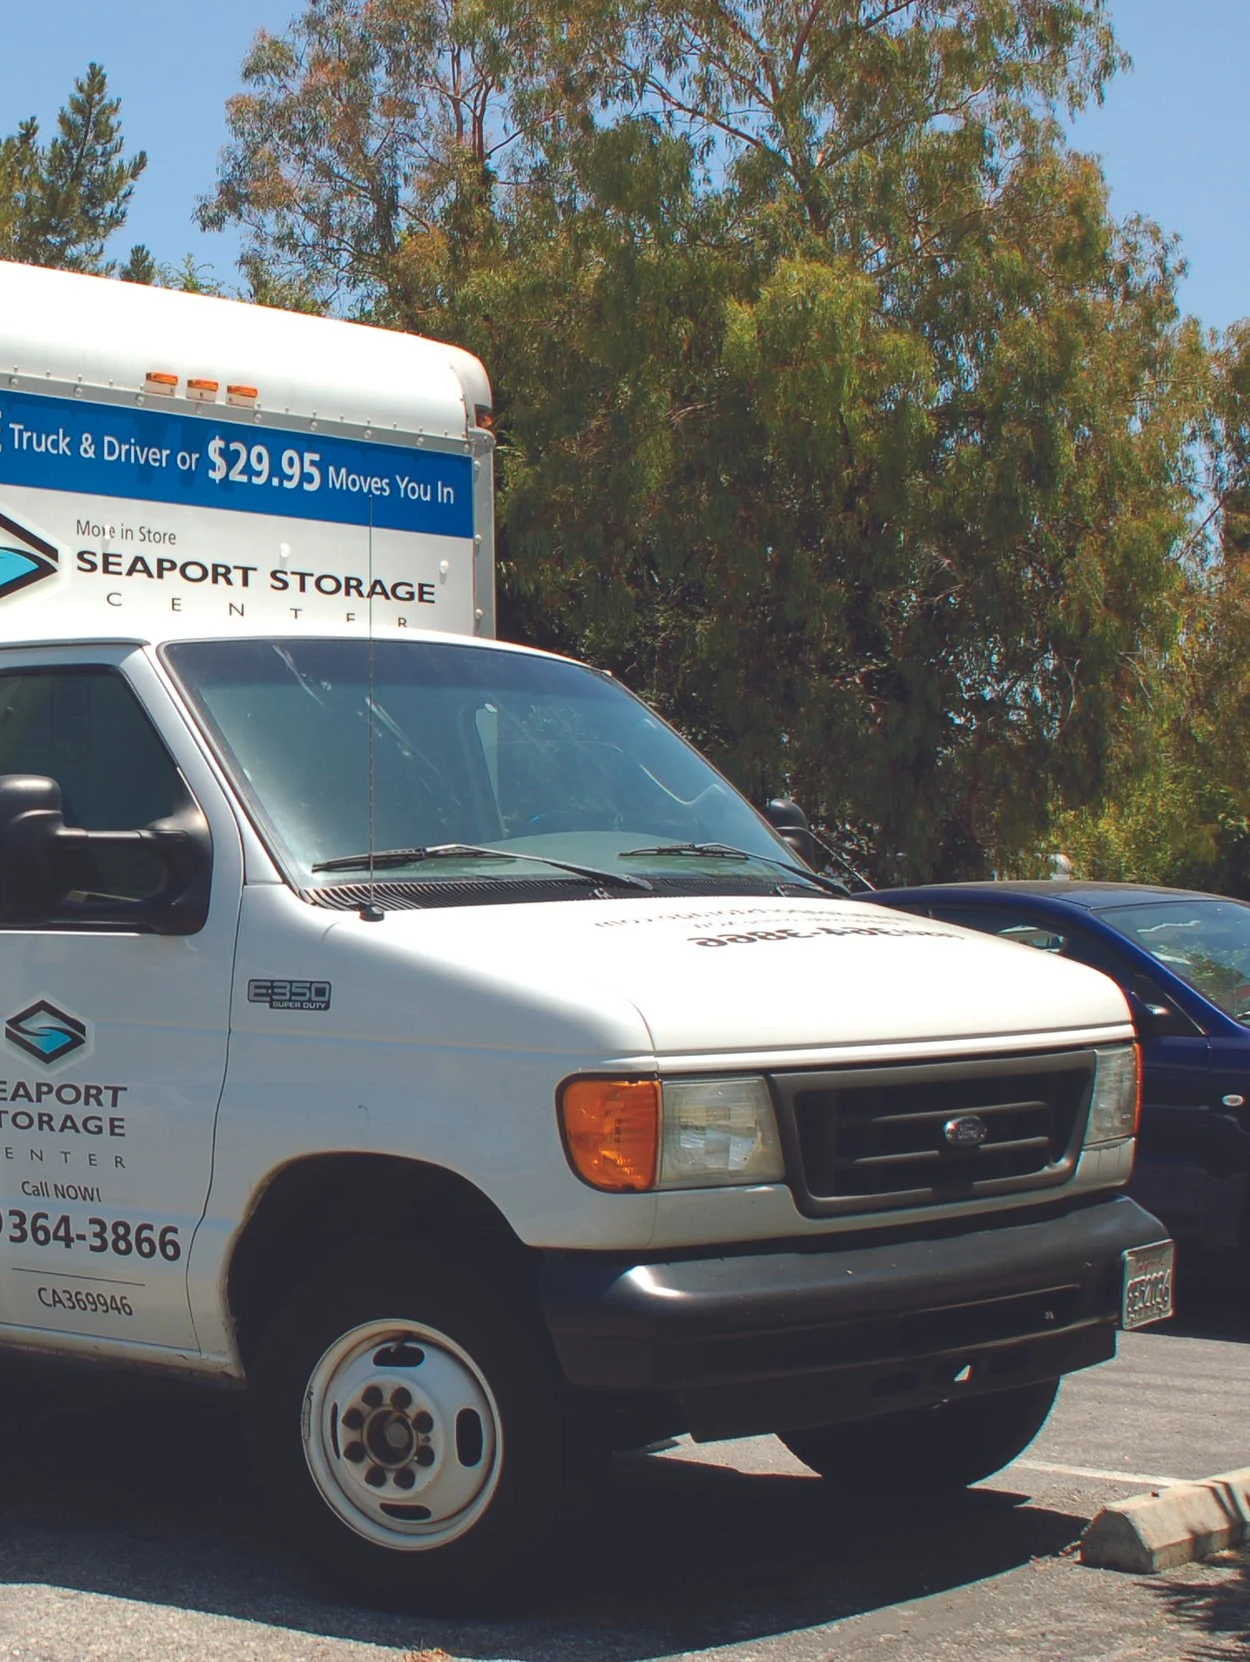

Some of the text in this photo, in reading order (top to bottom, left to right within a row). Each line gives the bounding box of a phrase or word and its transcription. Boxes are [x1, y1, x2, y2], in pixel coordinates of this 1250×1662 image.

[9, 423, 71, 456] Truck
[79, 432, 96, 459] &
[104, 436, 170, 468] Driver
[177, 451, 199, 471] or
[208, 435, 321, 491] $29.95
[328, 466, 391, 496] Moves
[396, 475, 431, 502] You
[438, 480, 455, 504] In
[120, 523, 134, 541] in
[139, 526, 177, 545] Store
[76, 550, 436, 604] SEAPORT STORAGE
[106, 592, 407, 628] CENTER
[20, 1181, 50, 1199] Call
[8, 1209, 182, 1262] 364-3866
[37, 1286, 134, 1316] CA369946
